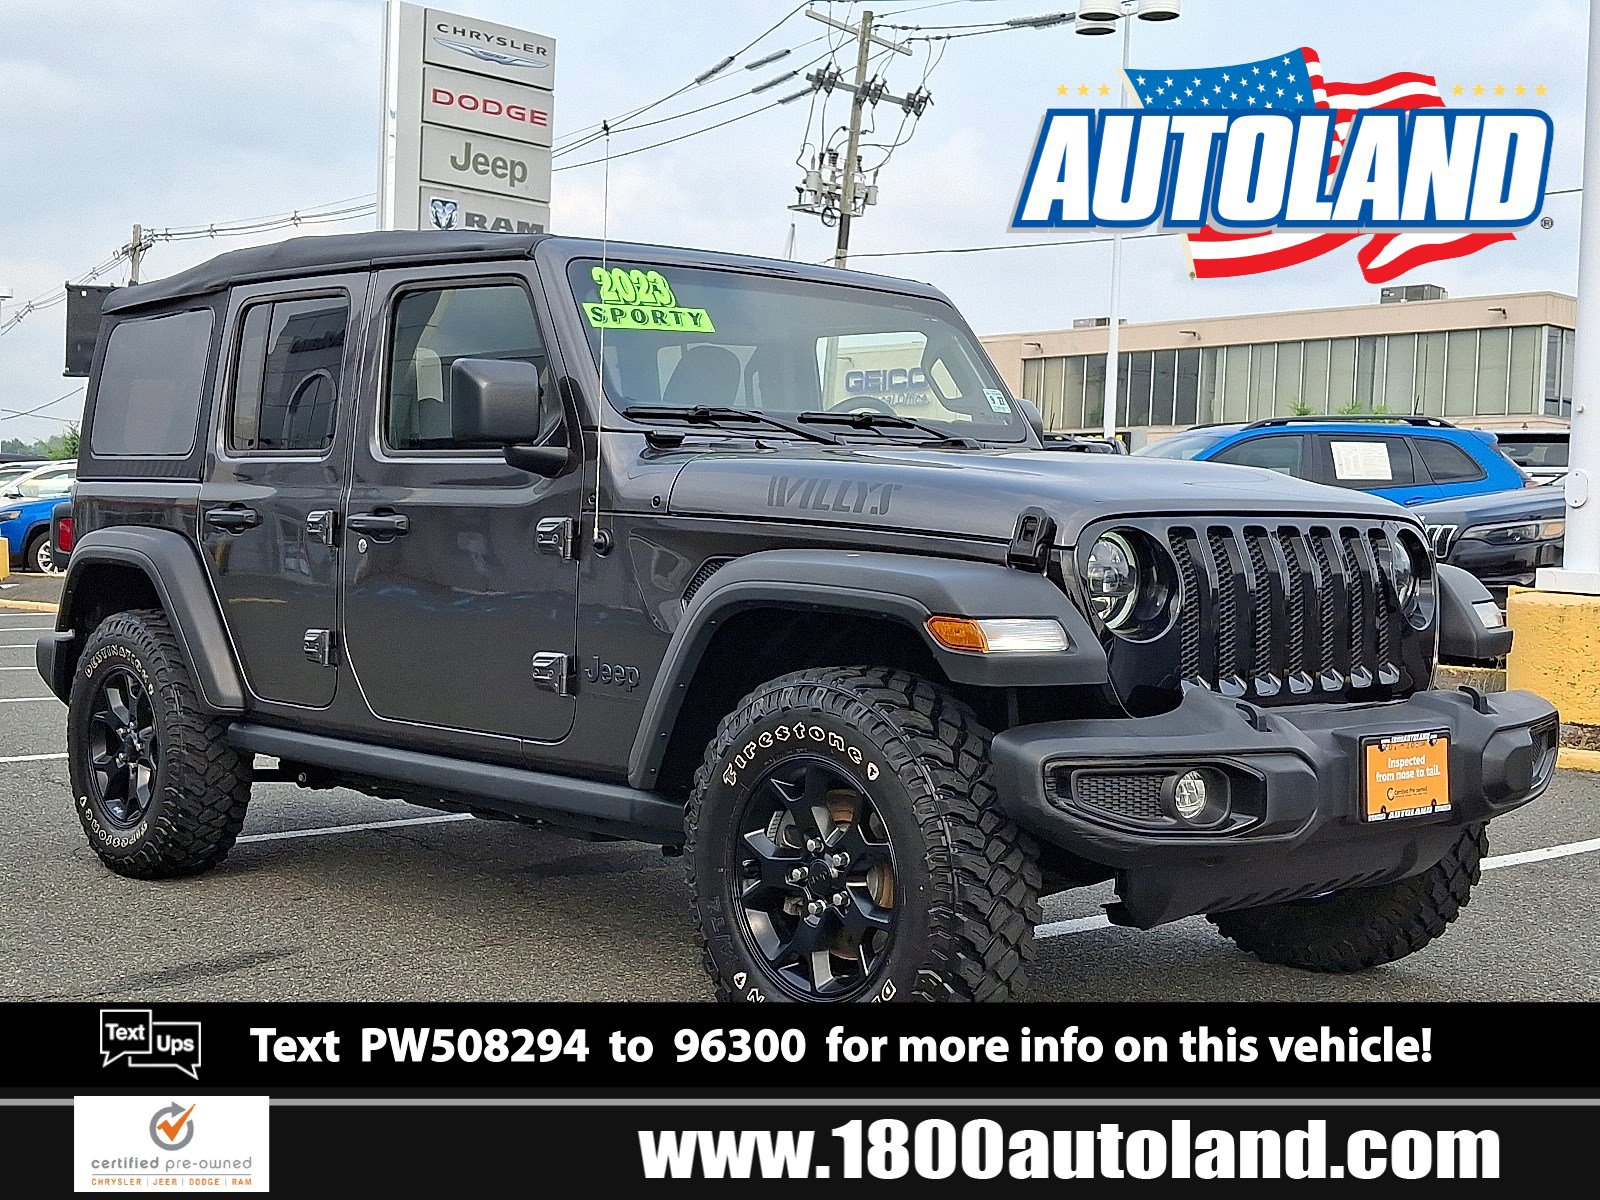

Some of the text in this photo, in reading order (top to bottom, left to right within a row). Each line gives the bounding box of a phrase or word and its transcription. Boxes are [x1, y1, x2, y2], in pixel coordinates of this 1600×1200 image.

[436, 23, 548, 57] CHRYSLER
[432, 88, 548, 127] DODGE
[450, 142, 528, 188] Jeep
[464, 211, 545, 235] RAM
[591, 266, 676, 308] 2023
[590, 306, 702, 327] SPORTY
[845, 367, 929, 393] GEICO
[767, 475, 903, 515] WILLYS
[583, 654, 641, 693] Jeep
[722, 721, 864, 787] Firestone
[1387, 753, 1426, 770] Inspected
[1375, 764, 1441, 783] from nose to tail.
[1387, 805, 1433, 820] AUTOLAND
